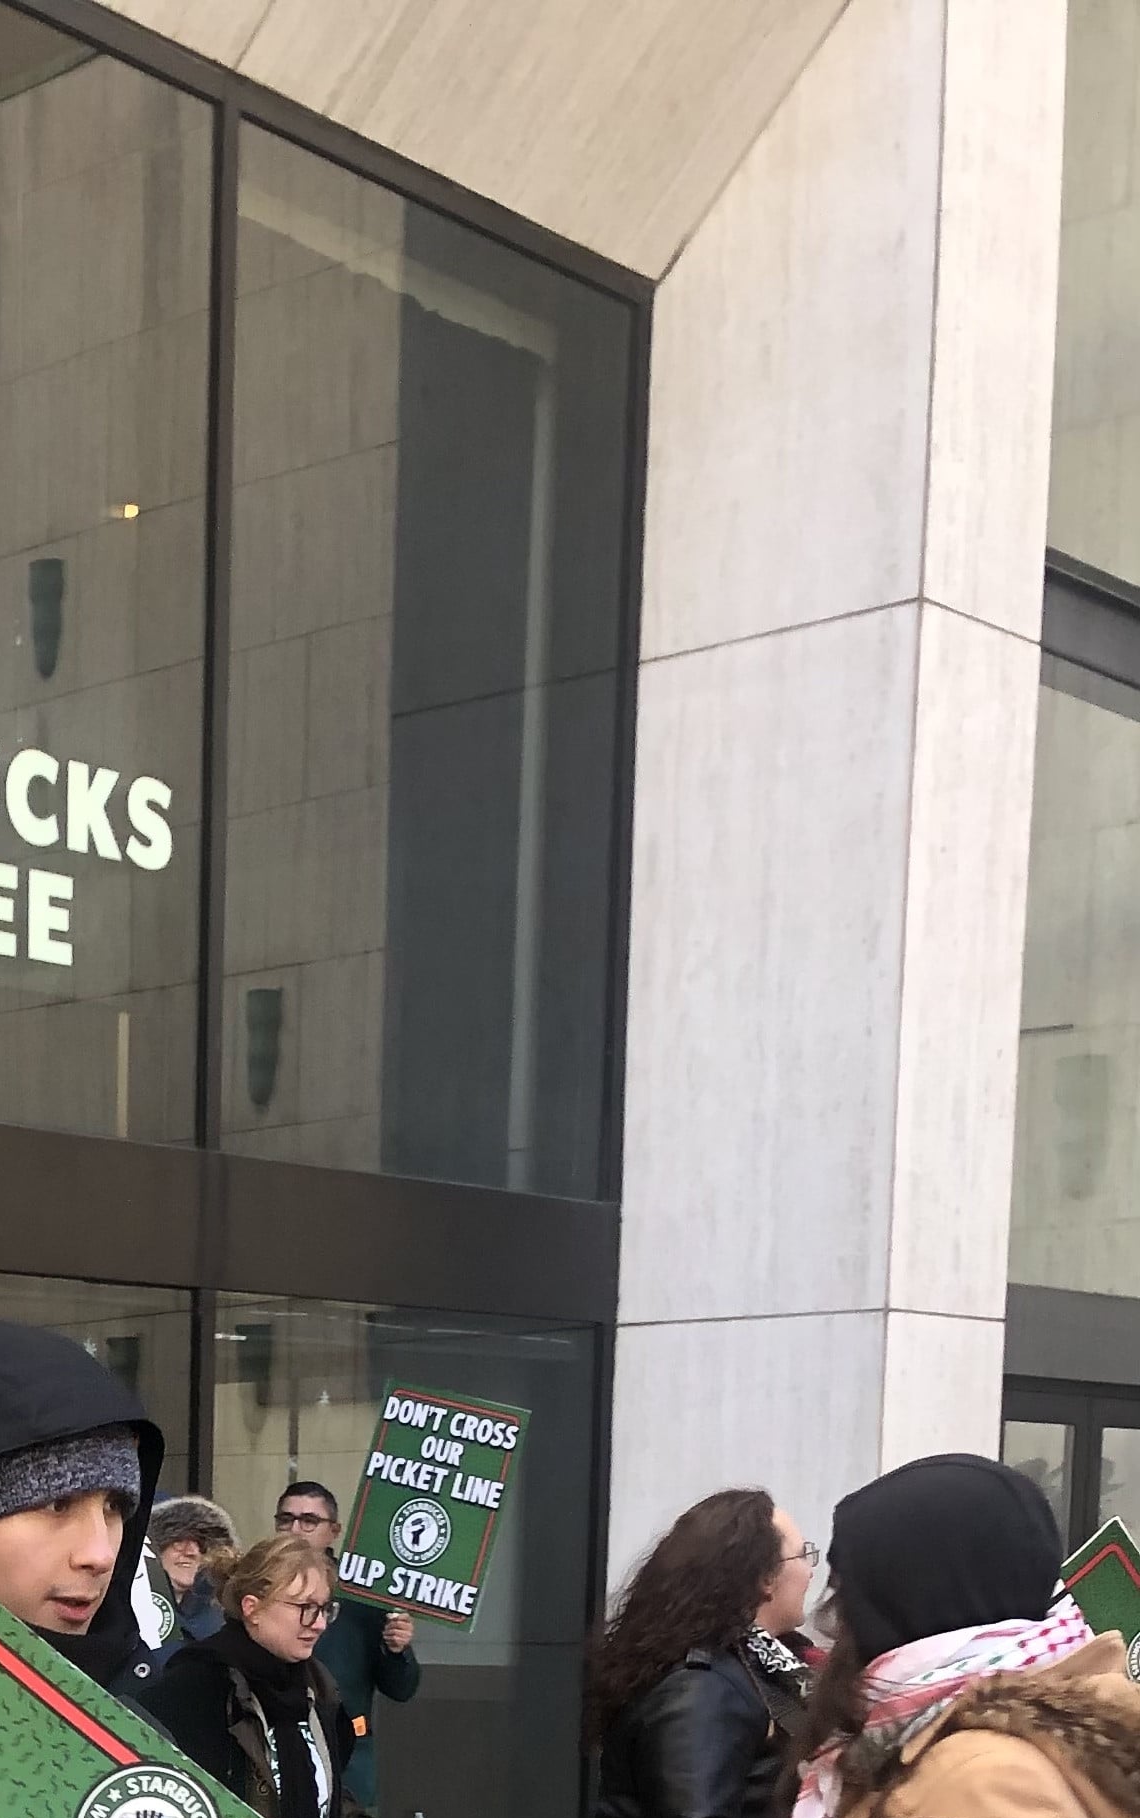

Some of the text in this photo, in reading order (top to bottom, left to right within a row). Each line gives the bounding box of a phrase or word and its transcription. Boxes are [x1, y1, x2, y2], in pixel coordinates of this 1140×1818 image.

[384, 1396, 519, 1450] DON'T CROSS
[421, 1436, 464, 1466] OUR
[366, 1452, 505, 1509] PICKET LINE
[338, 1552, 478, 1615] ULP STRIKE
